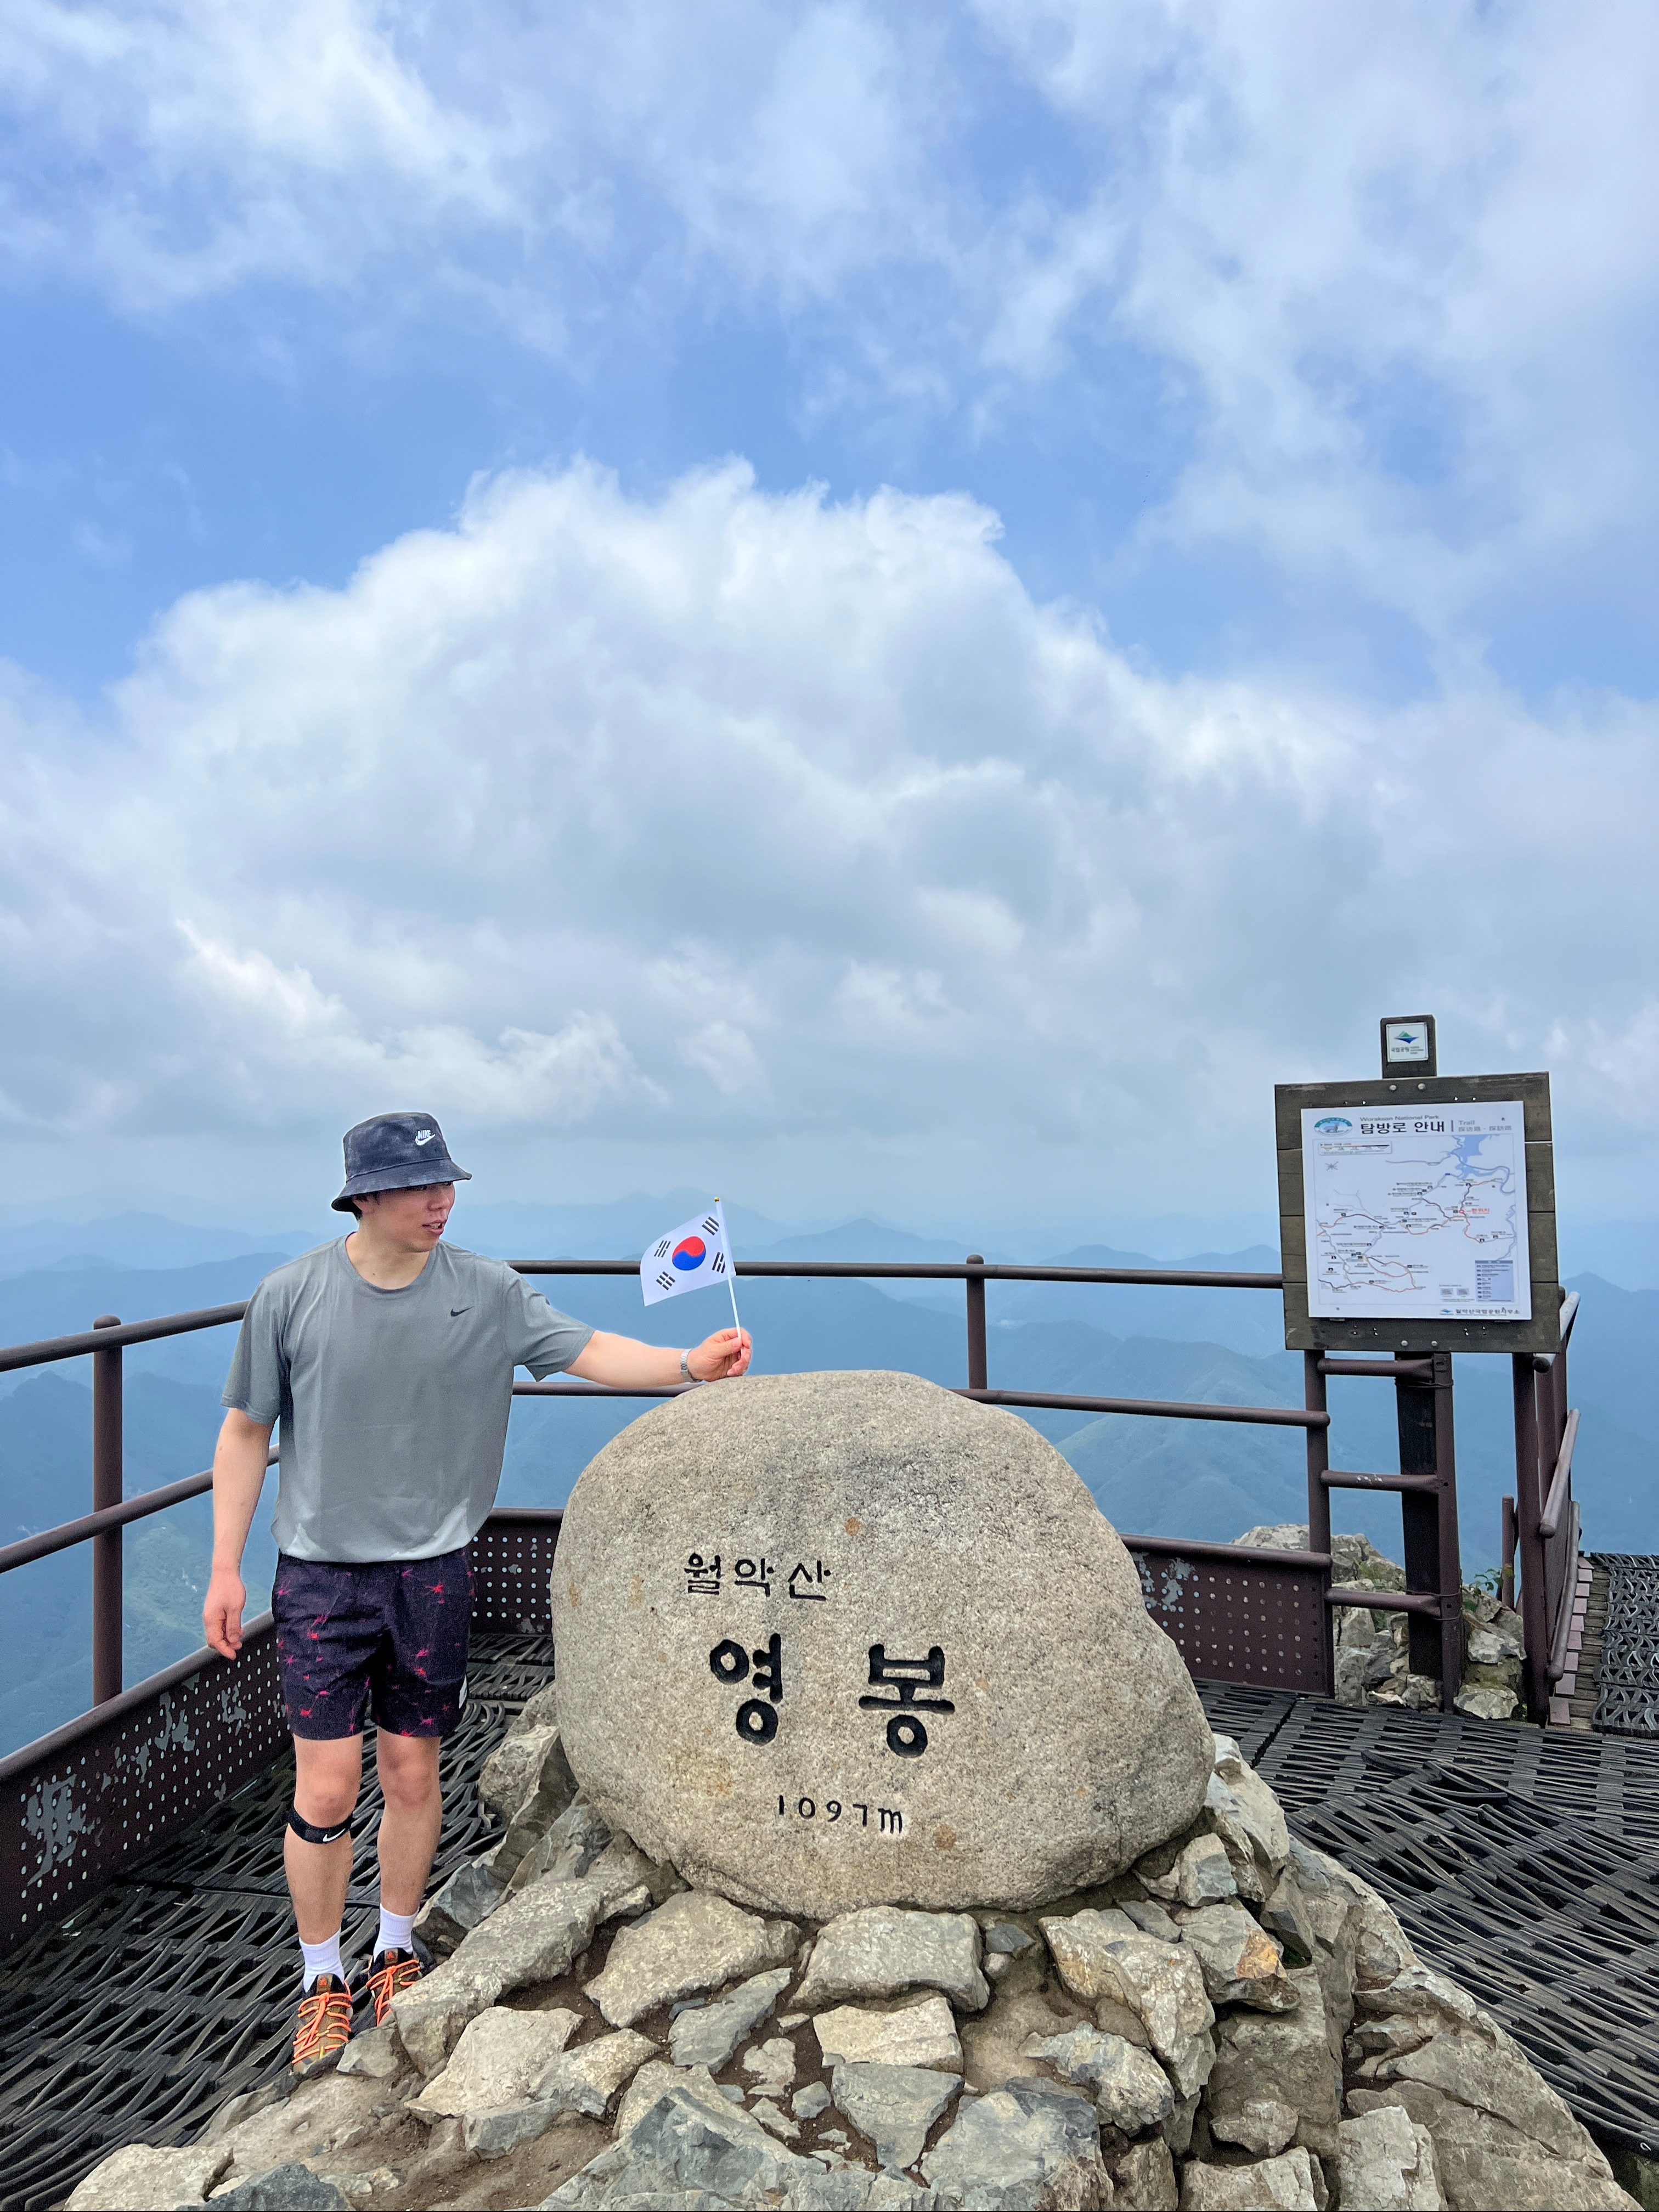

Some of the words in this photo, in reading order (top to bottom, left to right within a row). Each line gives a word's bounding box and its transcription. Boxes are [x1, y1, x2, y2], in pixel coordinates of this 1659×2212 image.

[417, 1130, 431, 1139] NIKE
[1361, 1122, 1407, 1134] 탐방로
[1414, 1121, 1444, 1133] 안내
[684, 1553, 831, 1600] 월악산
[778, 1795, 902, 1834] 1097m
